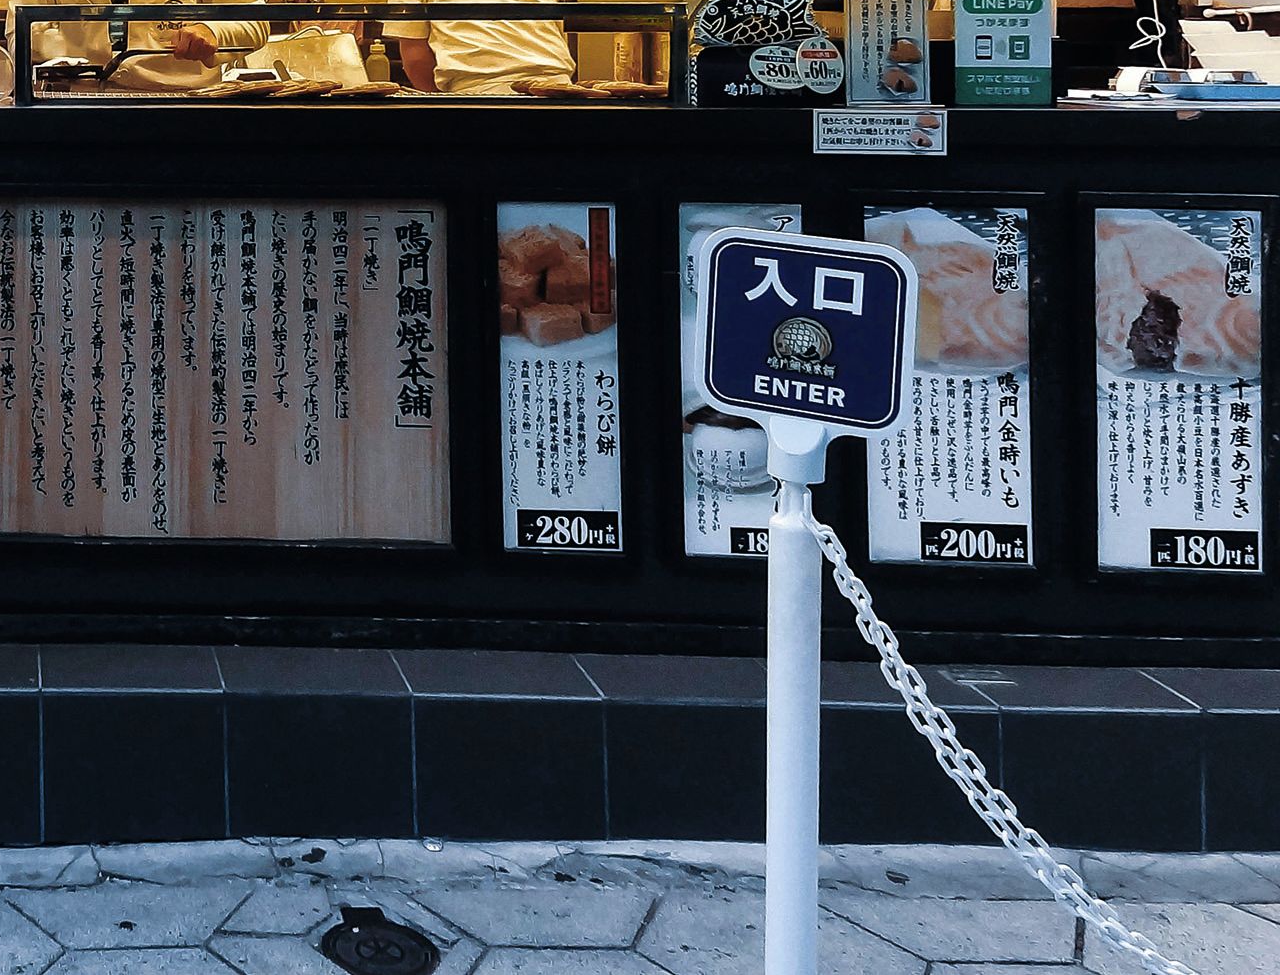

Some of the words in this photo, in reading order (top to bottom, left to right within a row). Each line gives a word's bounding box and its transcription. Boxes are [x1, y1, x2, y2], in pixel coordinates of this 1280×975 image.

[744, 256, 865, 316] 入口
[996, 214, 1020, 290] 天然鯛焼
[1230, 218, 1252, 295] 天然鯛焼
[593, 369, 617, 457] わらび餅
[754, 374, 846, 407] ENTER
[997, 371, 1021, 509] 鳴門金時いも
[1229, 377, 1253, 519] 十勝産あずき
[746, 532, 768, 553] 18
